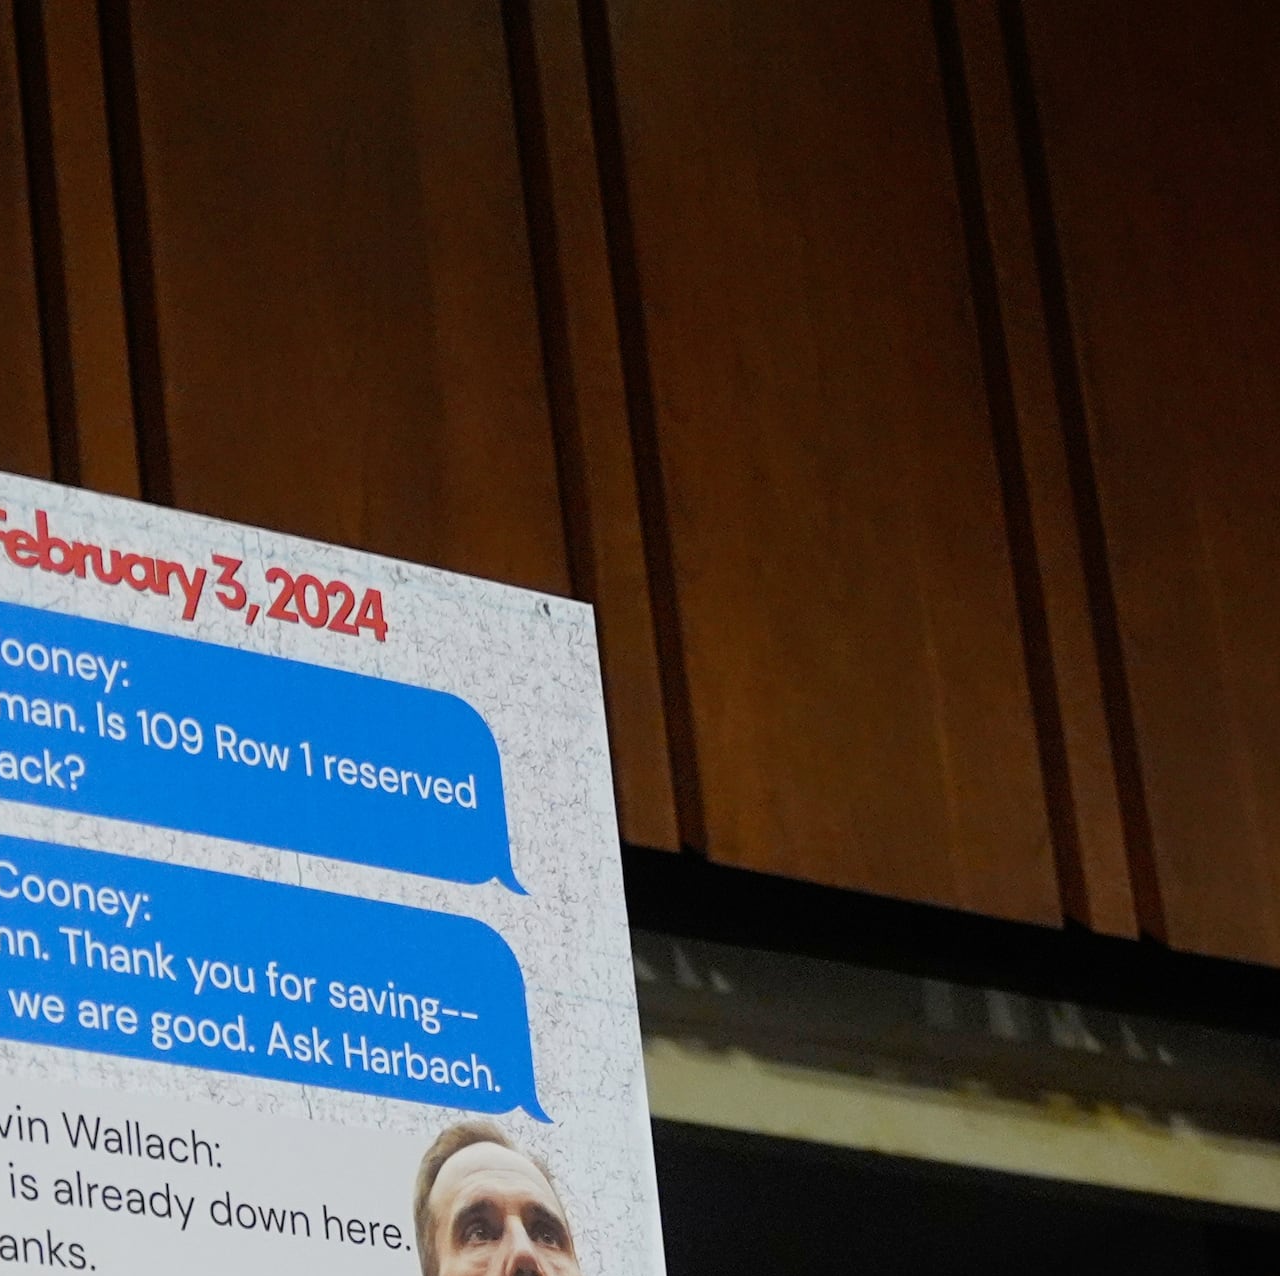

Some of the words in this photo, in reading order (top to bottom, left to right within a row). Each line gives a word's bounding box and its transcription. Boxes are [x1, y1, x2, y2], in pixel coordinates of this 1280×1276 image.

[265, 566, 388, 640] 2024
[95, 700, 127, 741] Is
[135, 709, 203, 755] 109
[214, 723, 289, 771] Row
[298, 741, 312, 777] 1
[323, 754, 477, 809] reserved
[58, 926, 177, 981] Thank
[186, 956, 256, 995] you
[264, 960, 317, 1003] for
[7, 988, 65, 1024] we
[77, 999, 138, 1035] are
[150, 1010, 255, 1053] good.
[266, 1020, 333, 1065] Ask
[341, 1032, 501, 1093] Harbach.
[61, 1110, 222, 1168] Wallach:
[7, 1161, 39, 1201] is
[53, 1169, 195, 1231] already
[209, 1190, 311, 1237] down
[321, 1203, 411, 1251] here.
